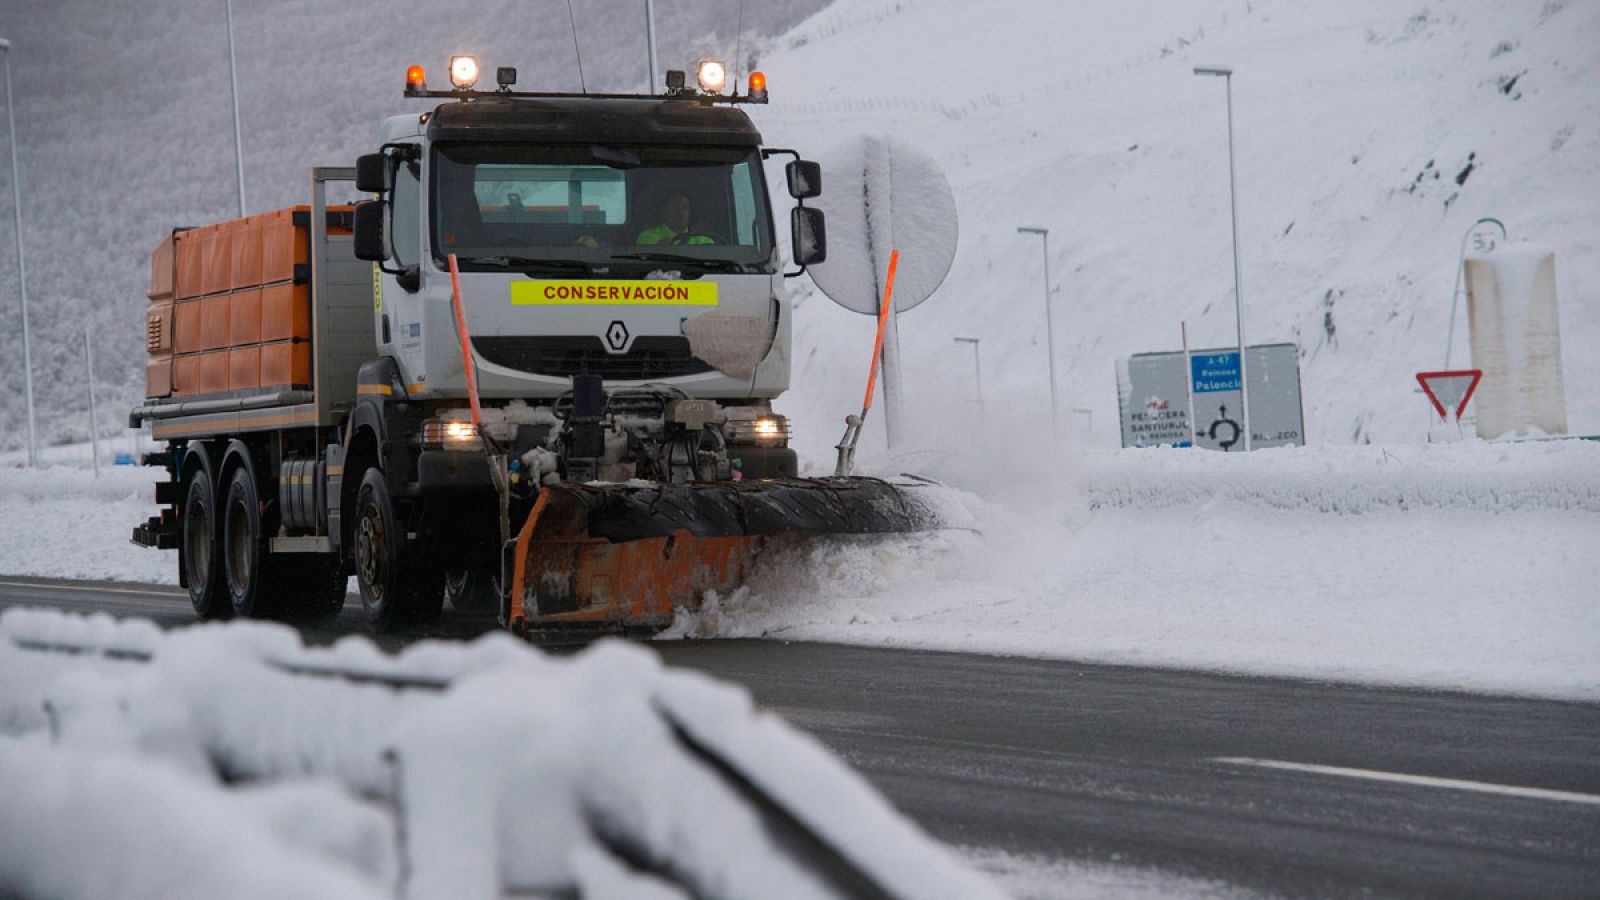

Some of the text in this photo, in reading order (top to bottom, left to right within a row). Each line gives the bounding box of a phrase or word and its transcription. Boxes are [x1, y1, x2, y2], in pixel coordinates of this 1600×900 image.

[543, 284, 689, 300] CONSERVACIÓN
[1195, 380, 1241, 391] Palenci
[1131, 410, 1185, 421] PEERA
